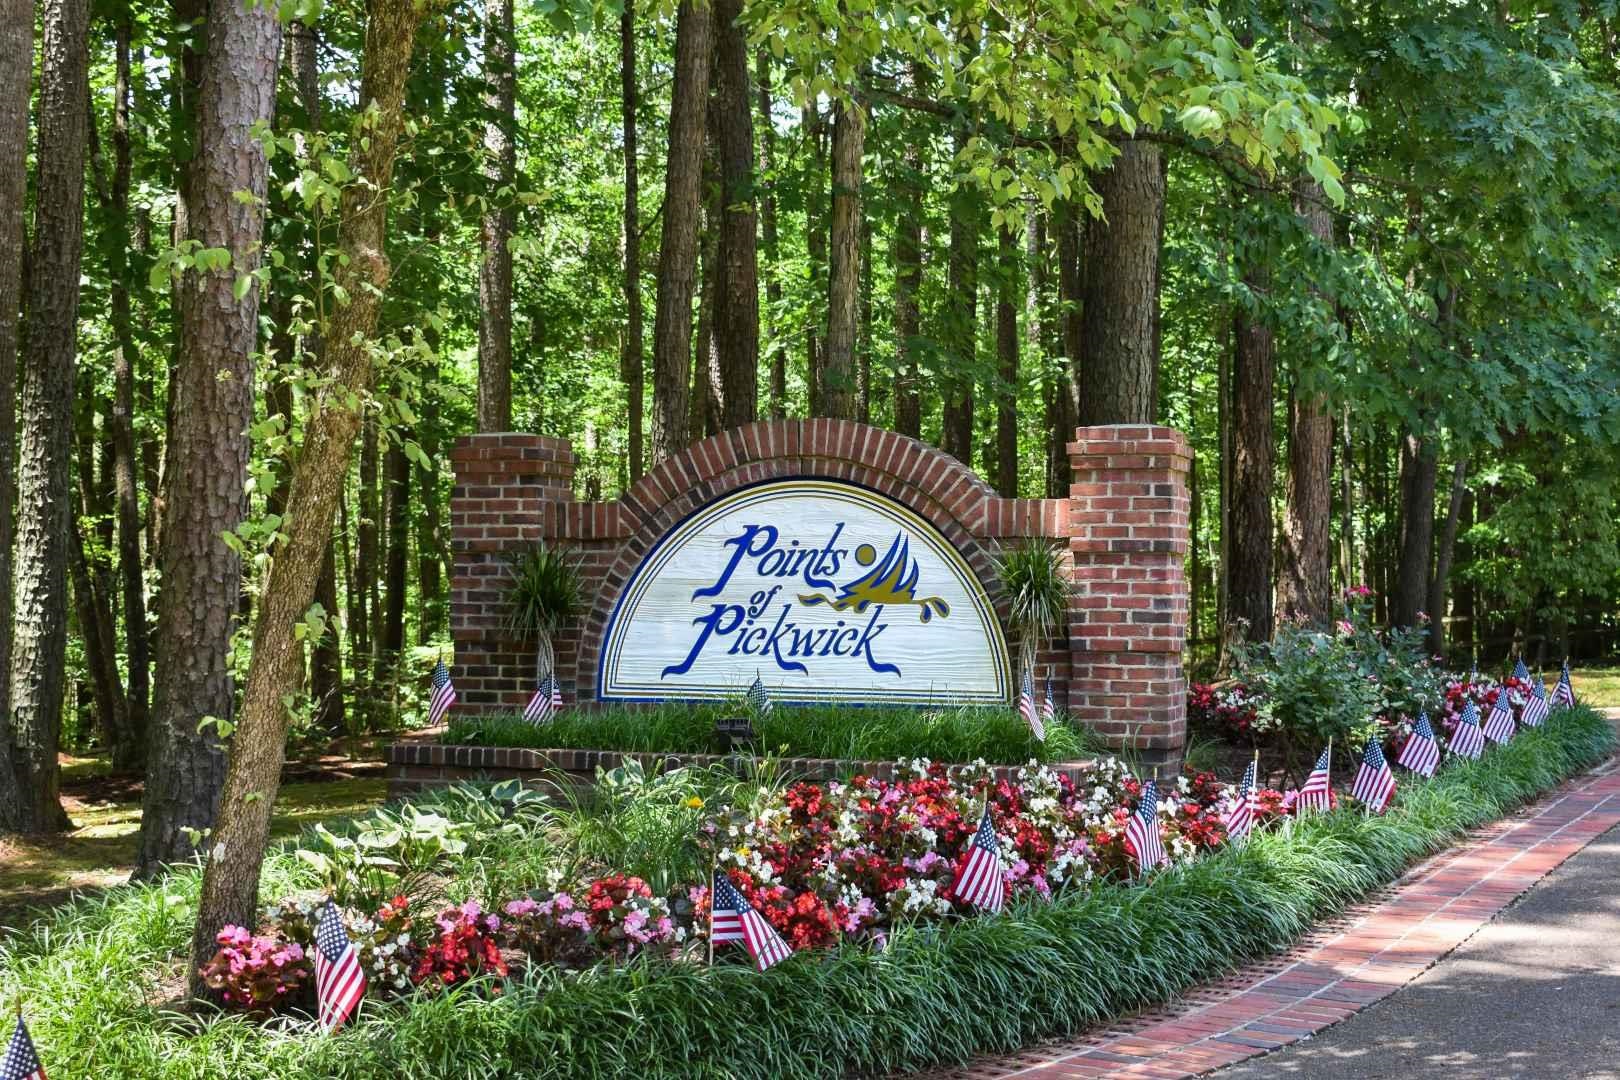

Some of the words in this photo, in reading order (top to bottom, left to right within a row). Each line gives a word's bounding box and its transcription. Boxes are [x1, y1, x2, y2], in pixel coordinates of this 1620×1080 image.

[691, 522, 848, 602] Points
[747, 584, 783, 619] of
[661, 604, 901, 680] Pickwick
